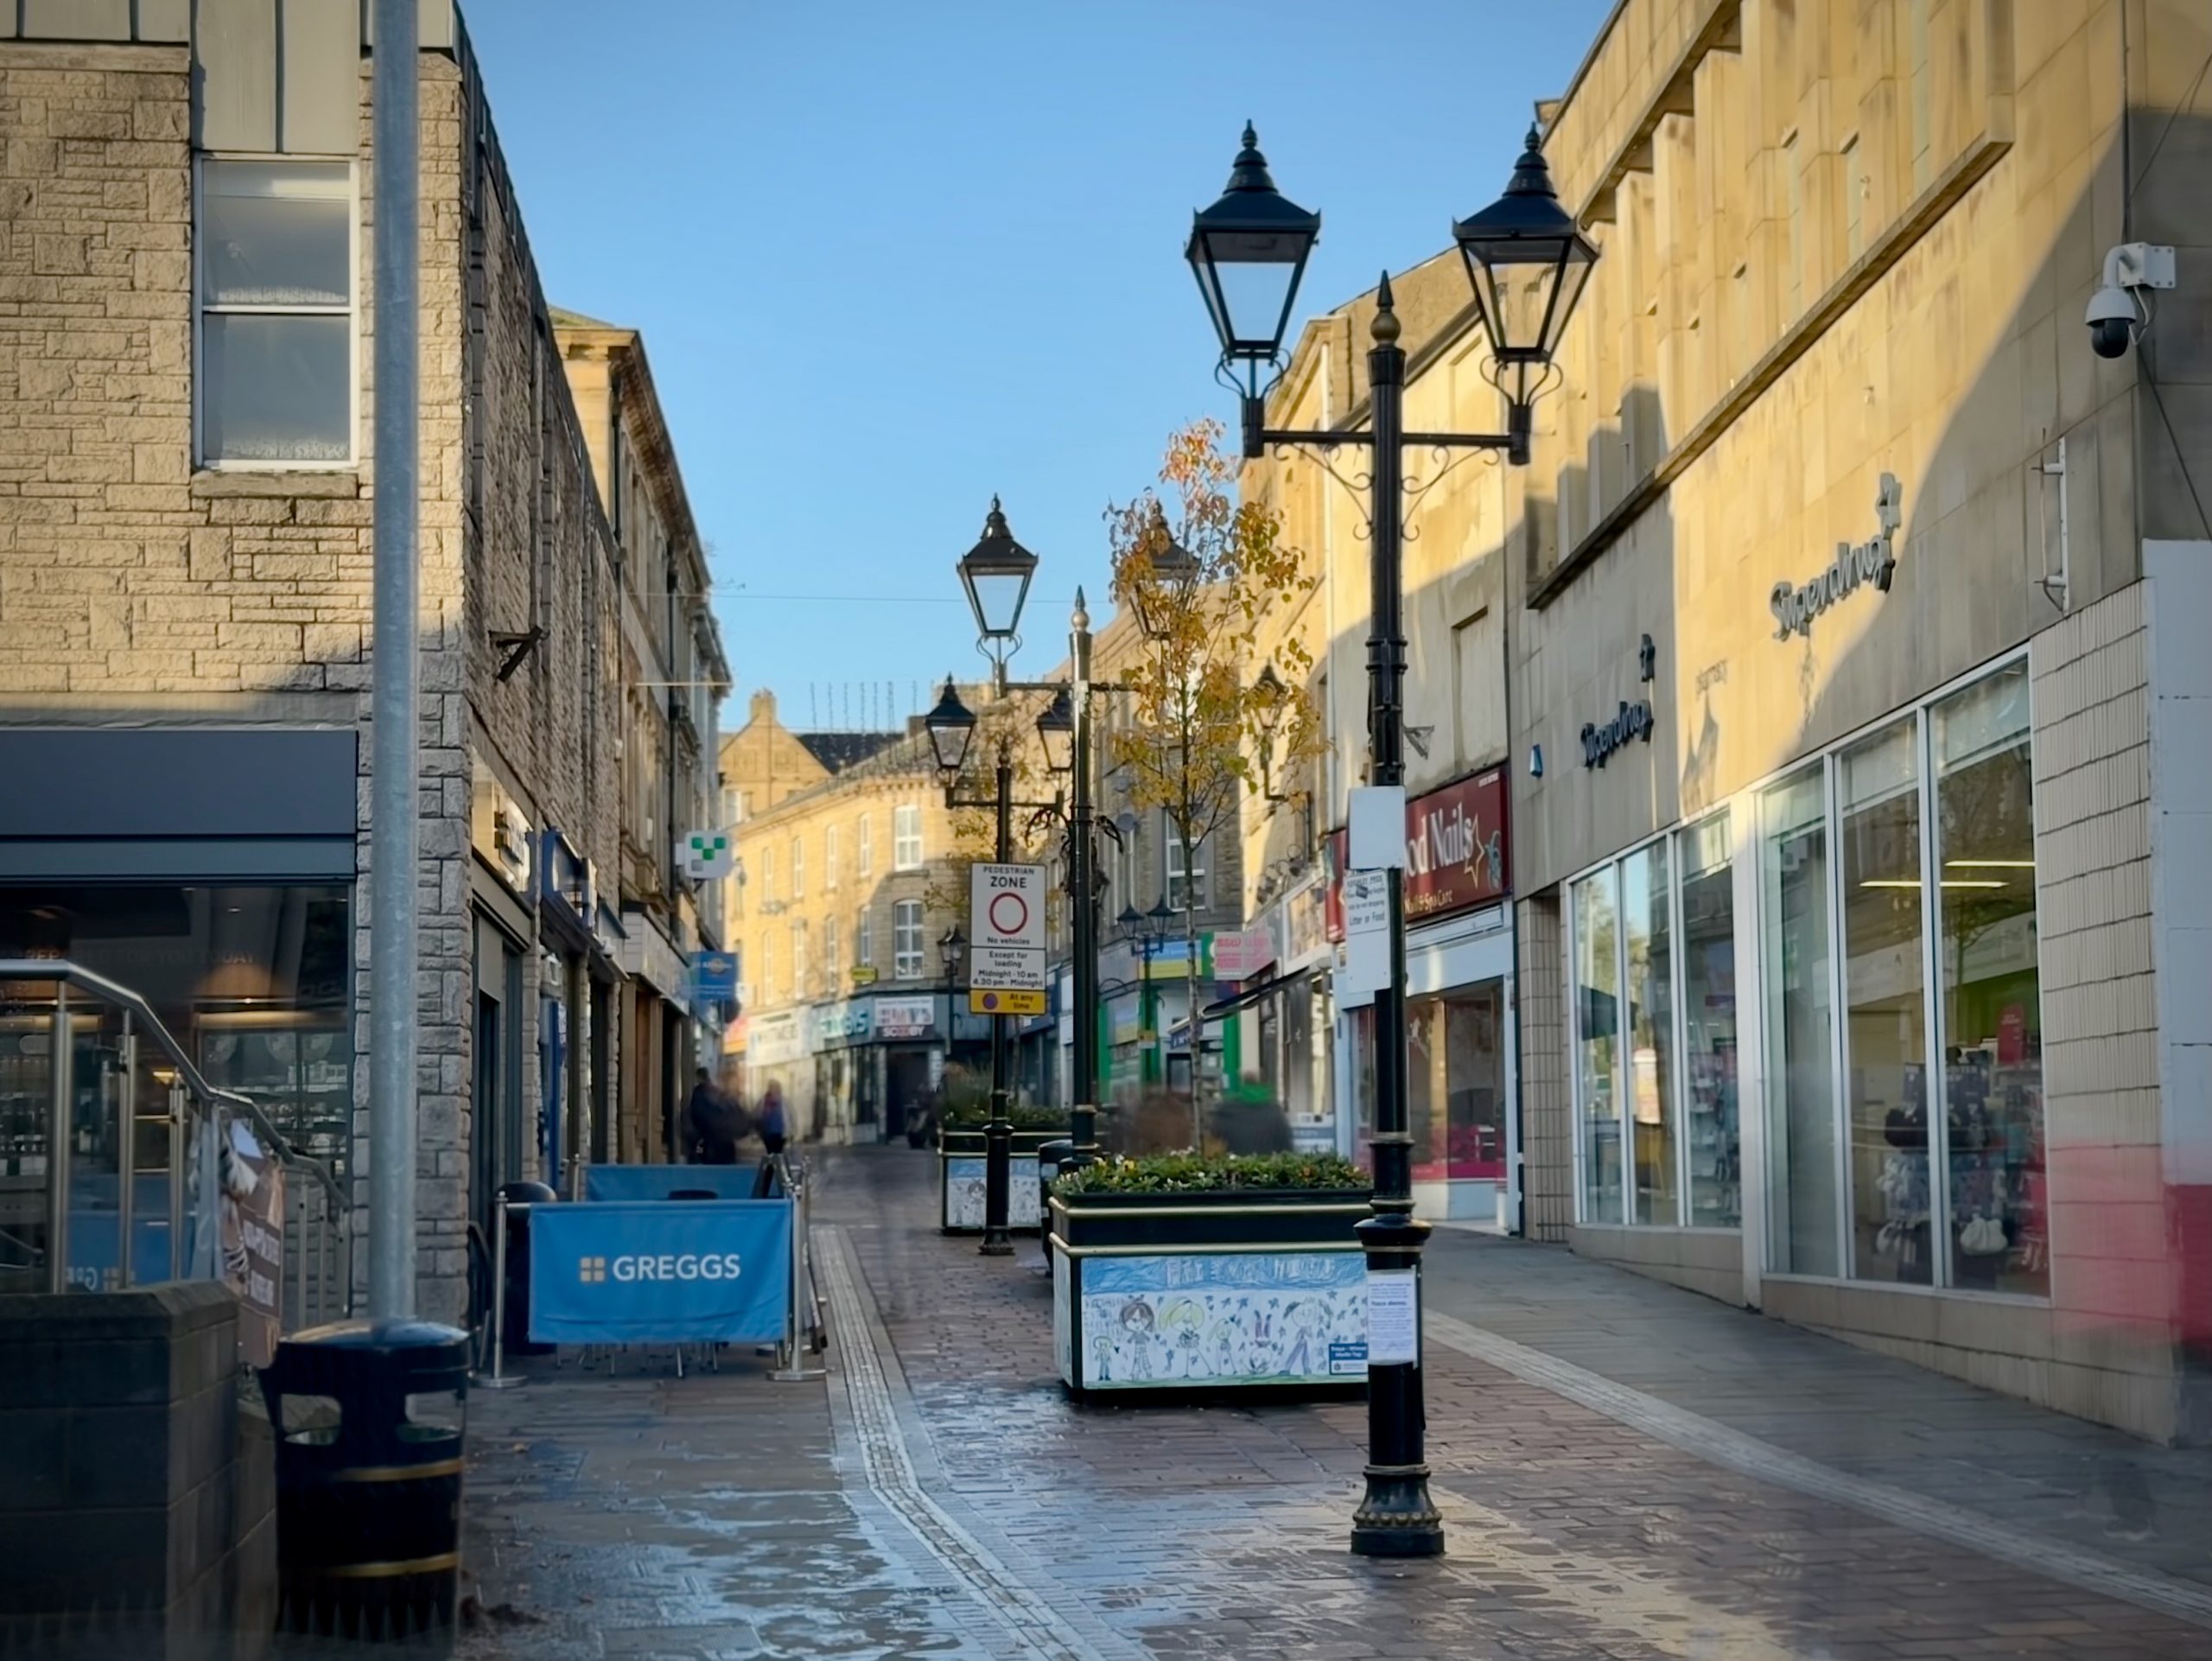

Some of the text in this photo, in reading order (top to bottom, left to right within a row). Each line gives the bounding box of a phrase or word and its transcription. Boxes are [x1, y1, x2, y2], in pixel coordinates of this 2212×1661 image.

[1770, 533, 1895, 643] Superdrug
[1580, 698, 1654, 769] Superdrug
[1430, 801, 1473, 871] Nails
[982, 866, 1035, 875] PEDESTRIAN
[989, 875, 1027, 888] ZONE
[1000, 937, 1030, 945] vehicles
[989, 951, 1015, 960] Except
[995, 960, 1022, 969] loading
[978, 969, 1012, 979] Midnight
[1010, 979, 1044, 989] Midnight
[612, 1253, 741, 1282] GREGGS
